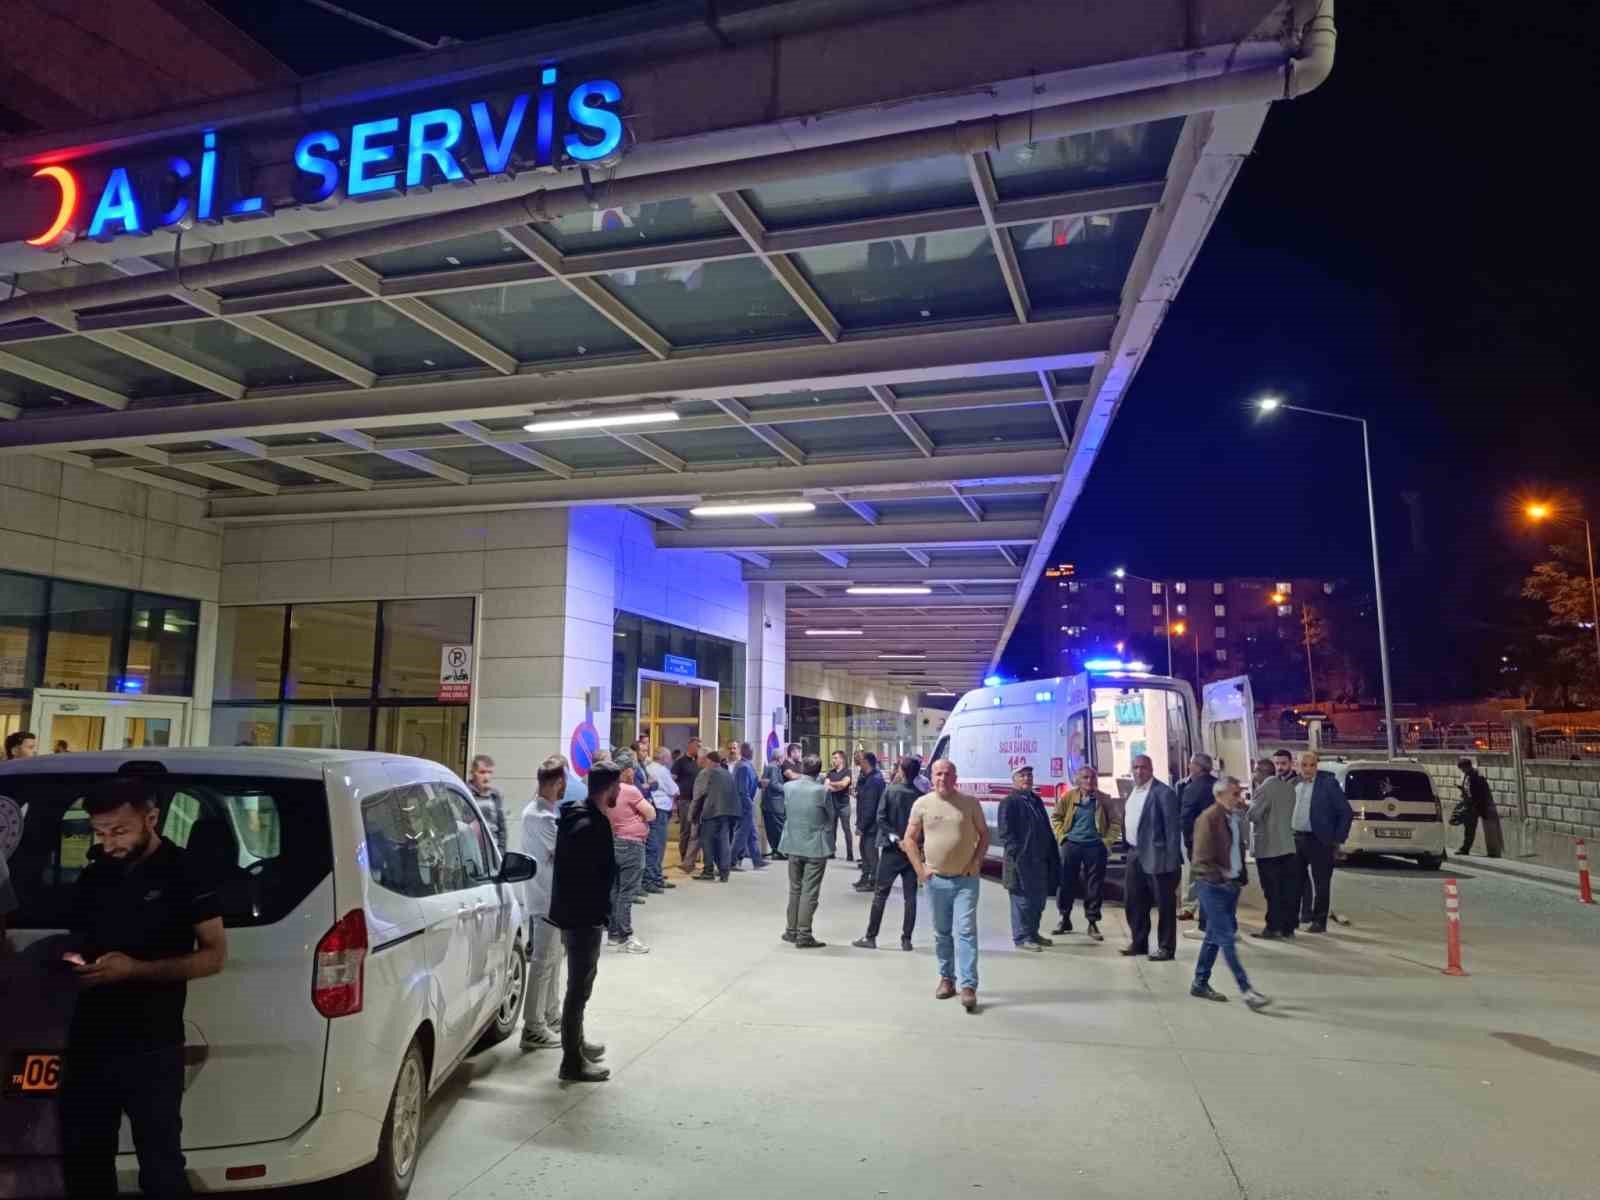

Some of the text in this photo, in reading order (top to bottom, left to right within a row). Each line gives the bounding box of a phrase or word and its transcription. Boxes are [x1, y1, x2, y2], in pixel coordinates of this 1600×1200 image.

[88, 68, 623, 236] ACİL SERVİS
[27, 1058, 61, 1087] 06
